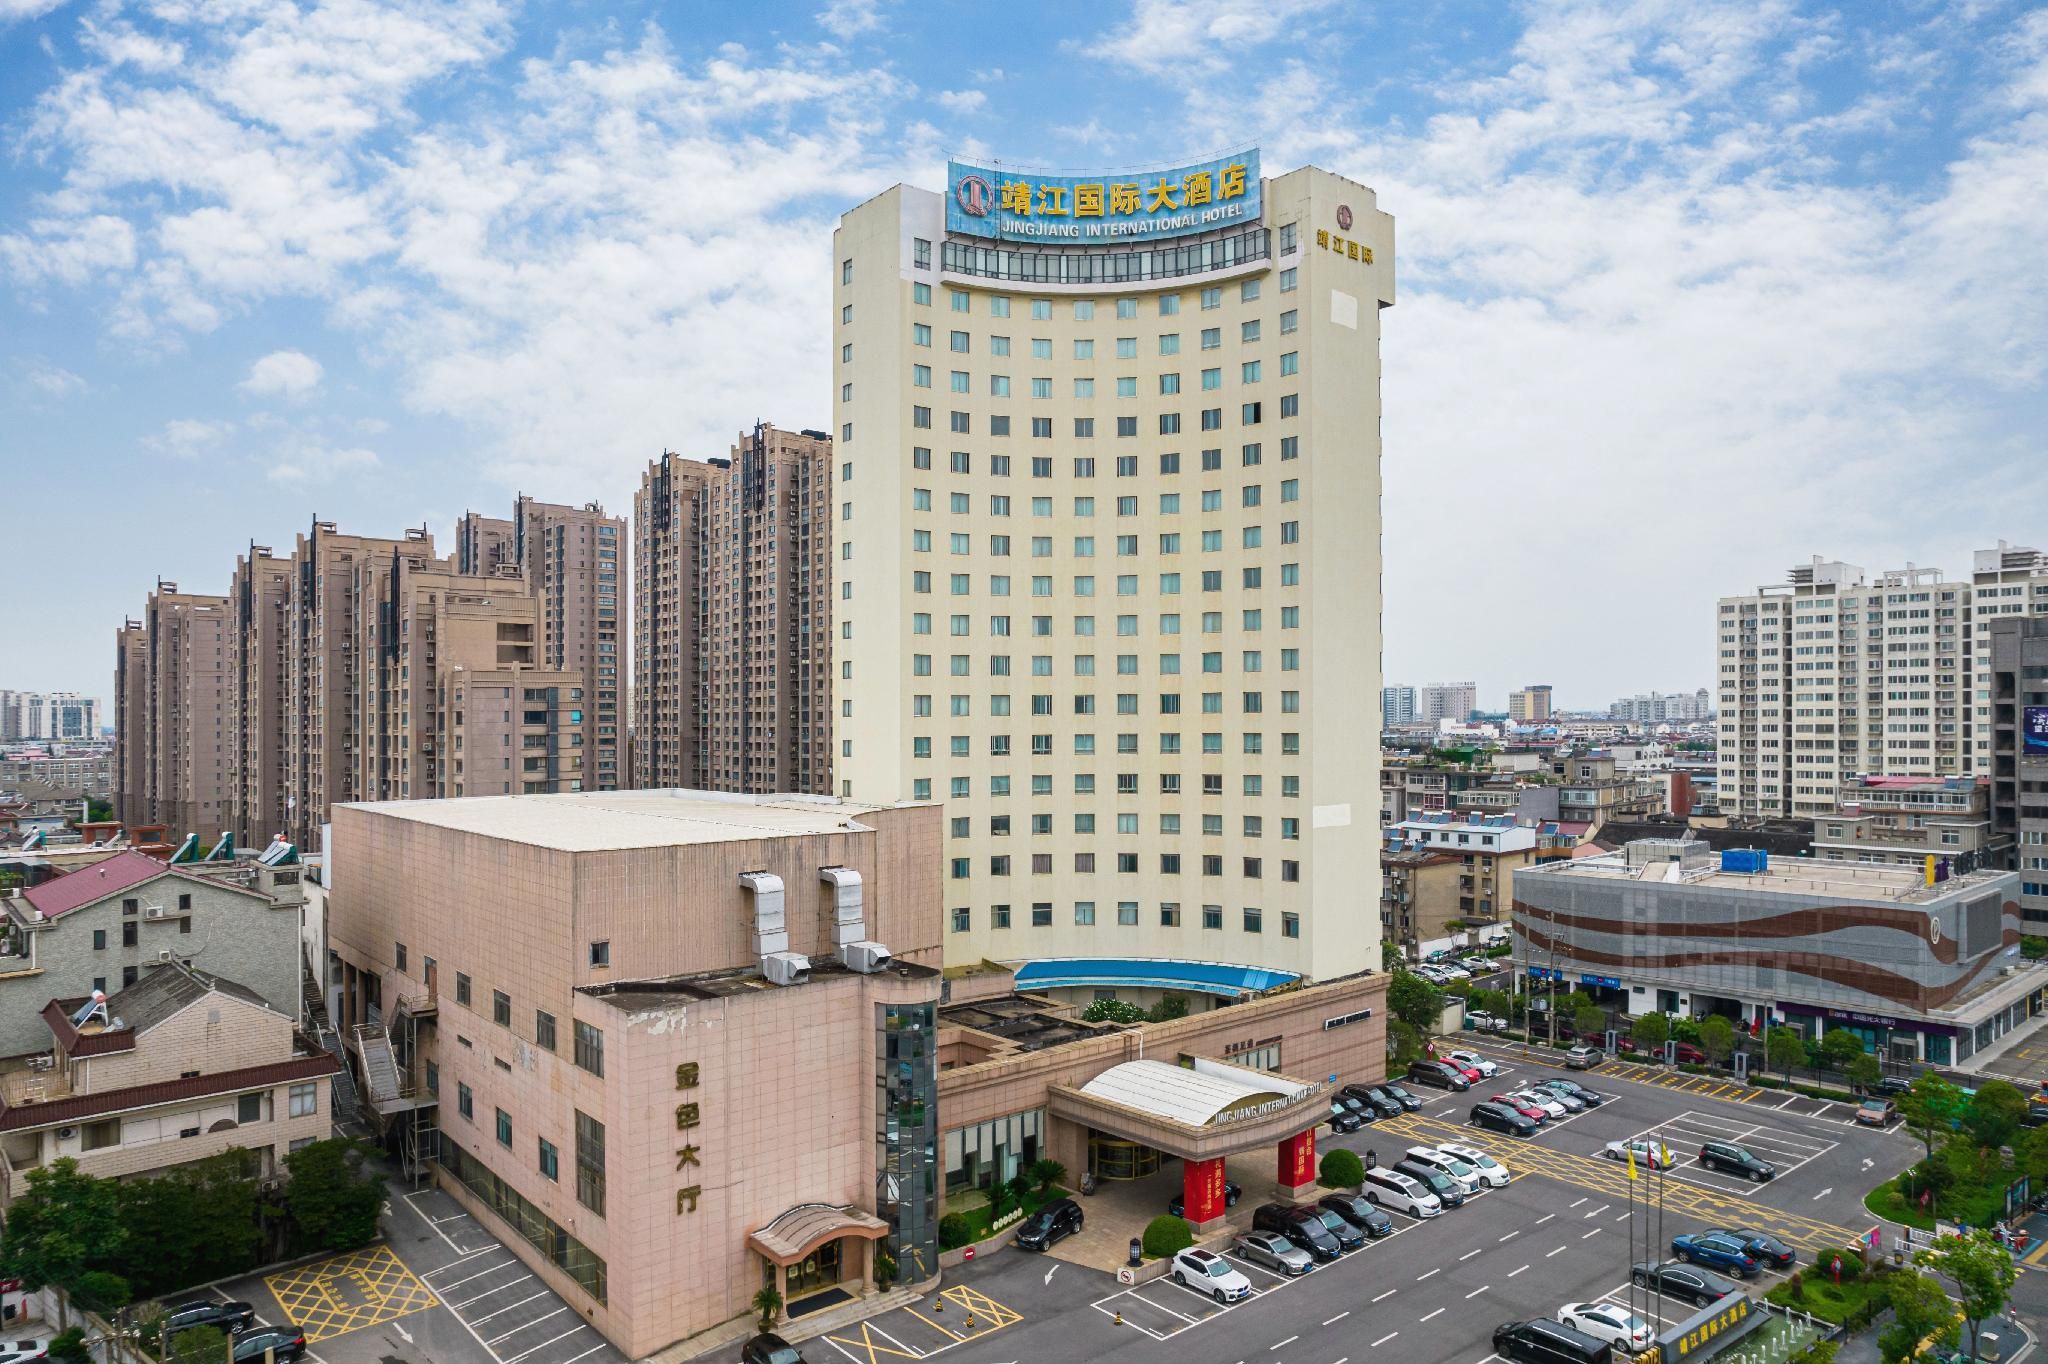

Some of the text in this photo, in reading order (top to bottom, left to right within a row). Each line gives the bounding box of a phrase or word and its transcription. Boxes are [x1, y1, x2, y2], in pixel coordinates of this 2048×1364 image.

[1001, 163, 1247, 218] 靖江国际大酒店
[1002, 203, 1243, 237] JINGJIANG INTERNATIONAL HOTEL
[1317, 229, 1374, 266] 靖江国际
[675, 1061, 702, 1216] 金色大厅
